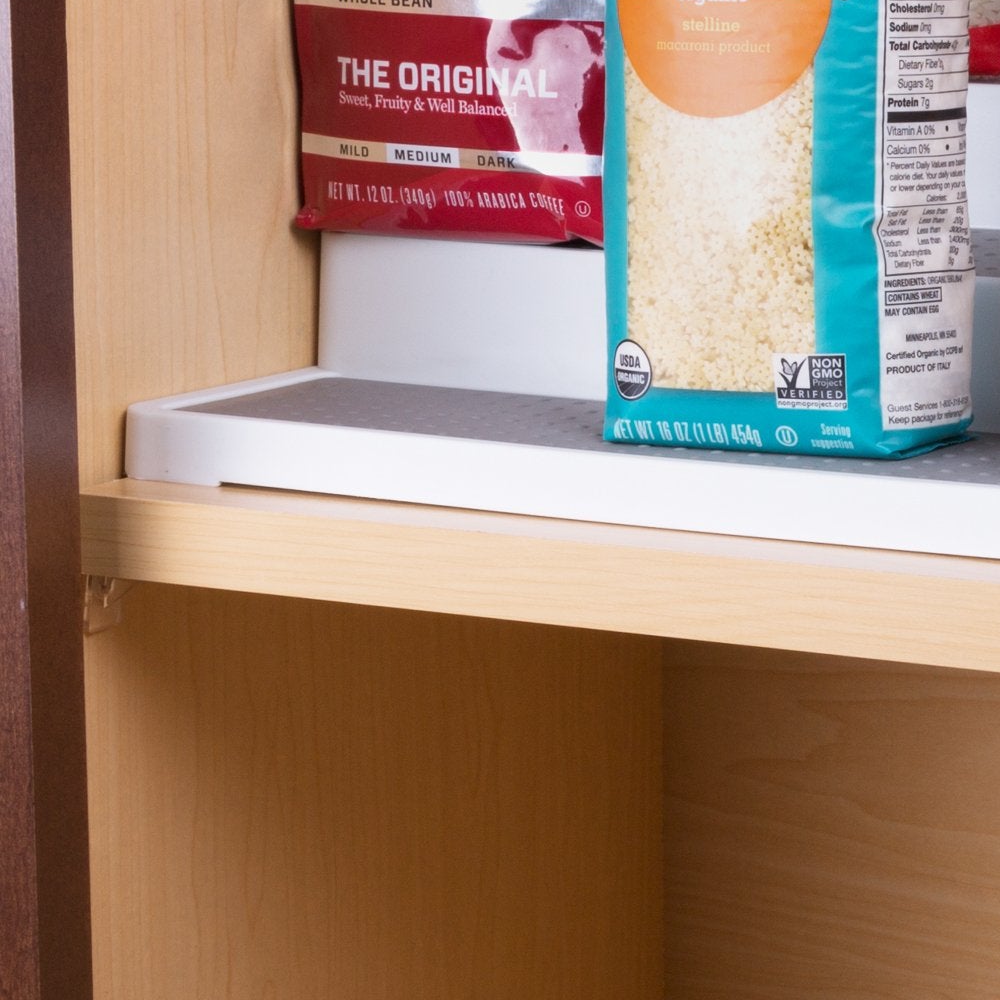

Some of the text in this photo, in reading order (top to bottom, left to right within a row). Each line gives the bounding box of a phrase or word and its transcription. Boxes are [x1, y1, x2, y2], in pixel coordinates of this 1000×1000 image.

[889, 3, 945, 15] Cholesterol 0mg
[682, 17, 741, 32] stelline
[889, 22, 931, 34] Sodium 0mg
[656, 40, 771, 55] macaroni product
[889, 41, 910, 51] Total
[899, 59, 924, 71] Dietary
[337, 56, 558, 99] THE ORIGINAL
[898, 77, 933, 91] Sugars 2g
[338, 90, 518, 117] Sweet, Fruity & Well Balanced
[888, 97, 930, 109] Protein 7g
[886, 124, 935, 136] Vitamin A 0%
[887, 143, 930, 155] Calcium 0%
[339, 143, 516, 169] MILD MEDIUM DARK
[890, 161, 915, 170] Percent
[916, 161, 930, 170] Daily
[889, 173, 911, 181] calorie
[898, 184, 915, 192] lower
[916, 183, 943, 191] depending
[328, 181, 565, 216] NET WT. 12 OZ. (340g) 100% ARABICA COFFEE
[888, 290, 939, 302] CONTAINS WHEAT
[885, 305, 939, 317] MAY CONTAIN EGG
[886, 349, 939, 360] Certified Organic
[619, 353, 641, 369] USDA
[811, 358, 842, 368] NON
[811, 368, 843, 379] GMO
[886, 362, 951, 374] PRODUCT OF ITALY
[618, 371, 645, 385] ORGANIC
[812, 379, 842, 389] Project
[780, 389, 843, 399] VERIFIED
[778, 400, 847, 409] nongmoproject.org
[887, 404, 912, 412] Guest
[914, 401, 938, 411] Services
[888, 415, 910, 424] Keep
[911, 413, 936, 424] package
[613, 418, 763, 447] NET WT 16 OZ (1 LB) 454g
[820, 423, 851, 438] Serving
[811, 438, 854, 450] suggestion
